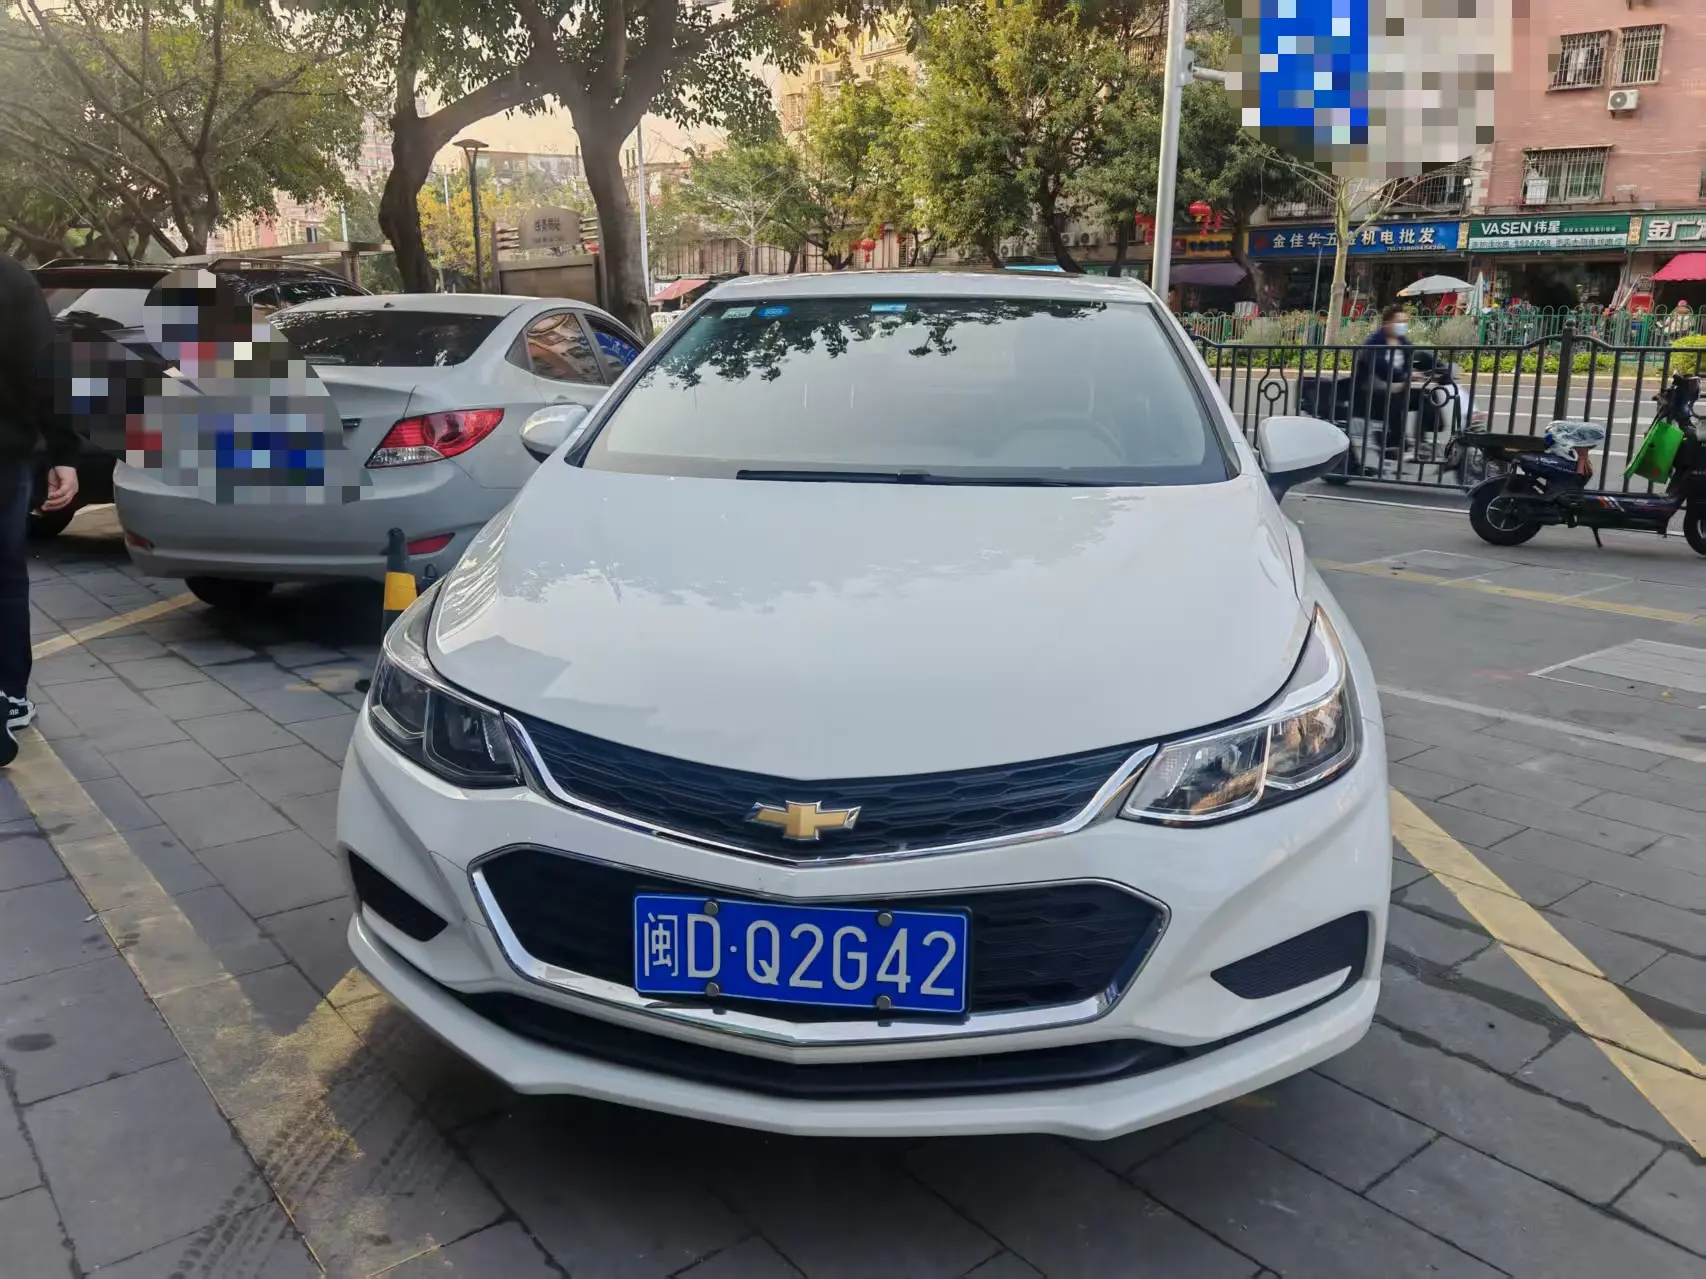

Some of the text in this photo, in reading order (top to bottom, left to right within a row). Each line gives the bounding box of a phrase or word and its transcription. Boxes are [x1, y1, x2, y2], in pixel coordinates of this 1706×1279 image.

[1481, 221, 1531, 235] VASEN
[1534, 220, 1561, 234] 伟星
[643, 912, 956, 996] 闽D·Q2G42
